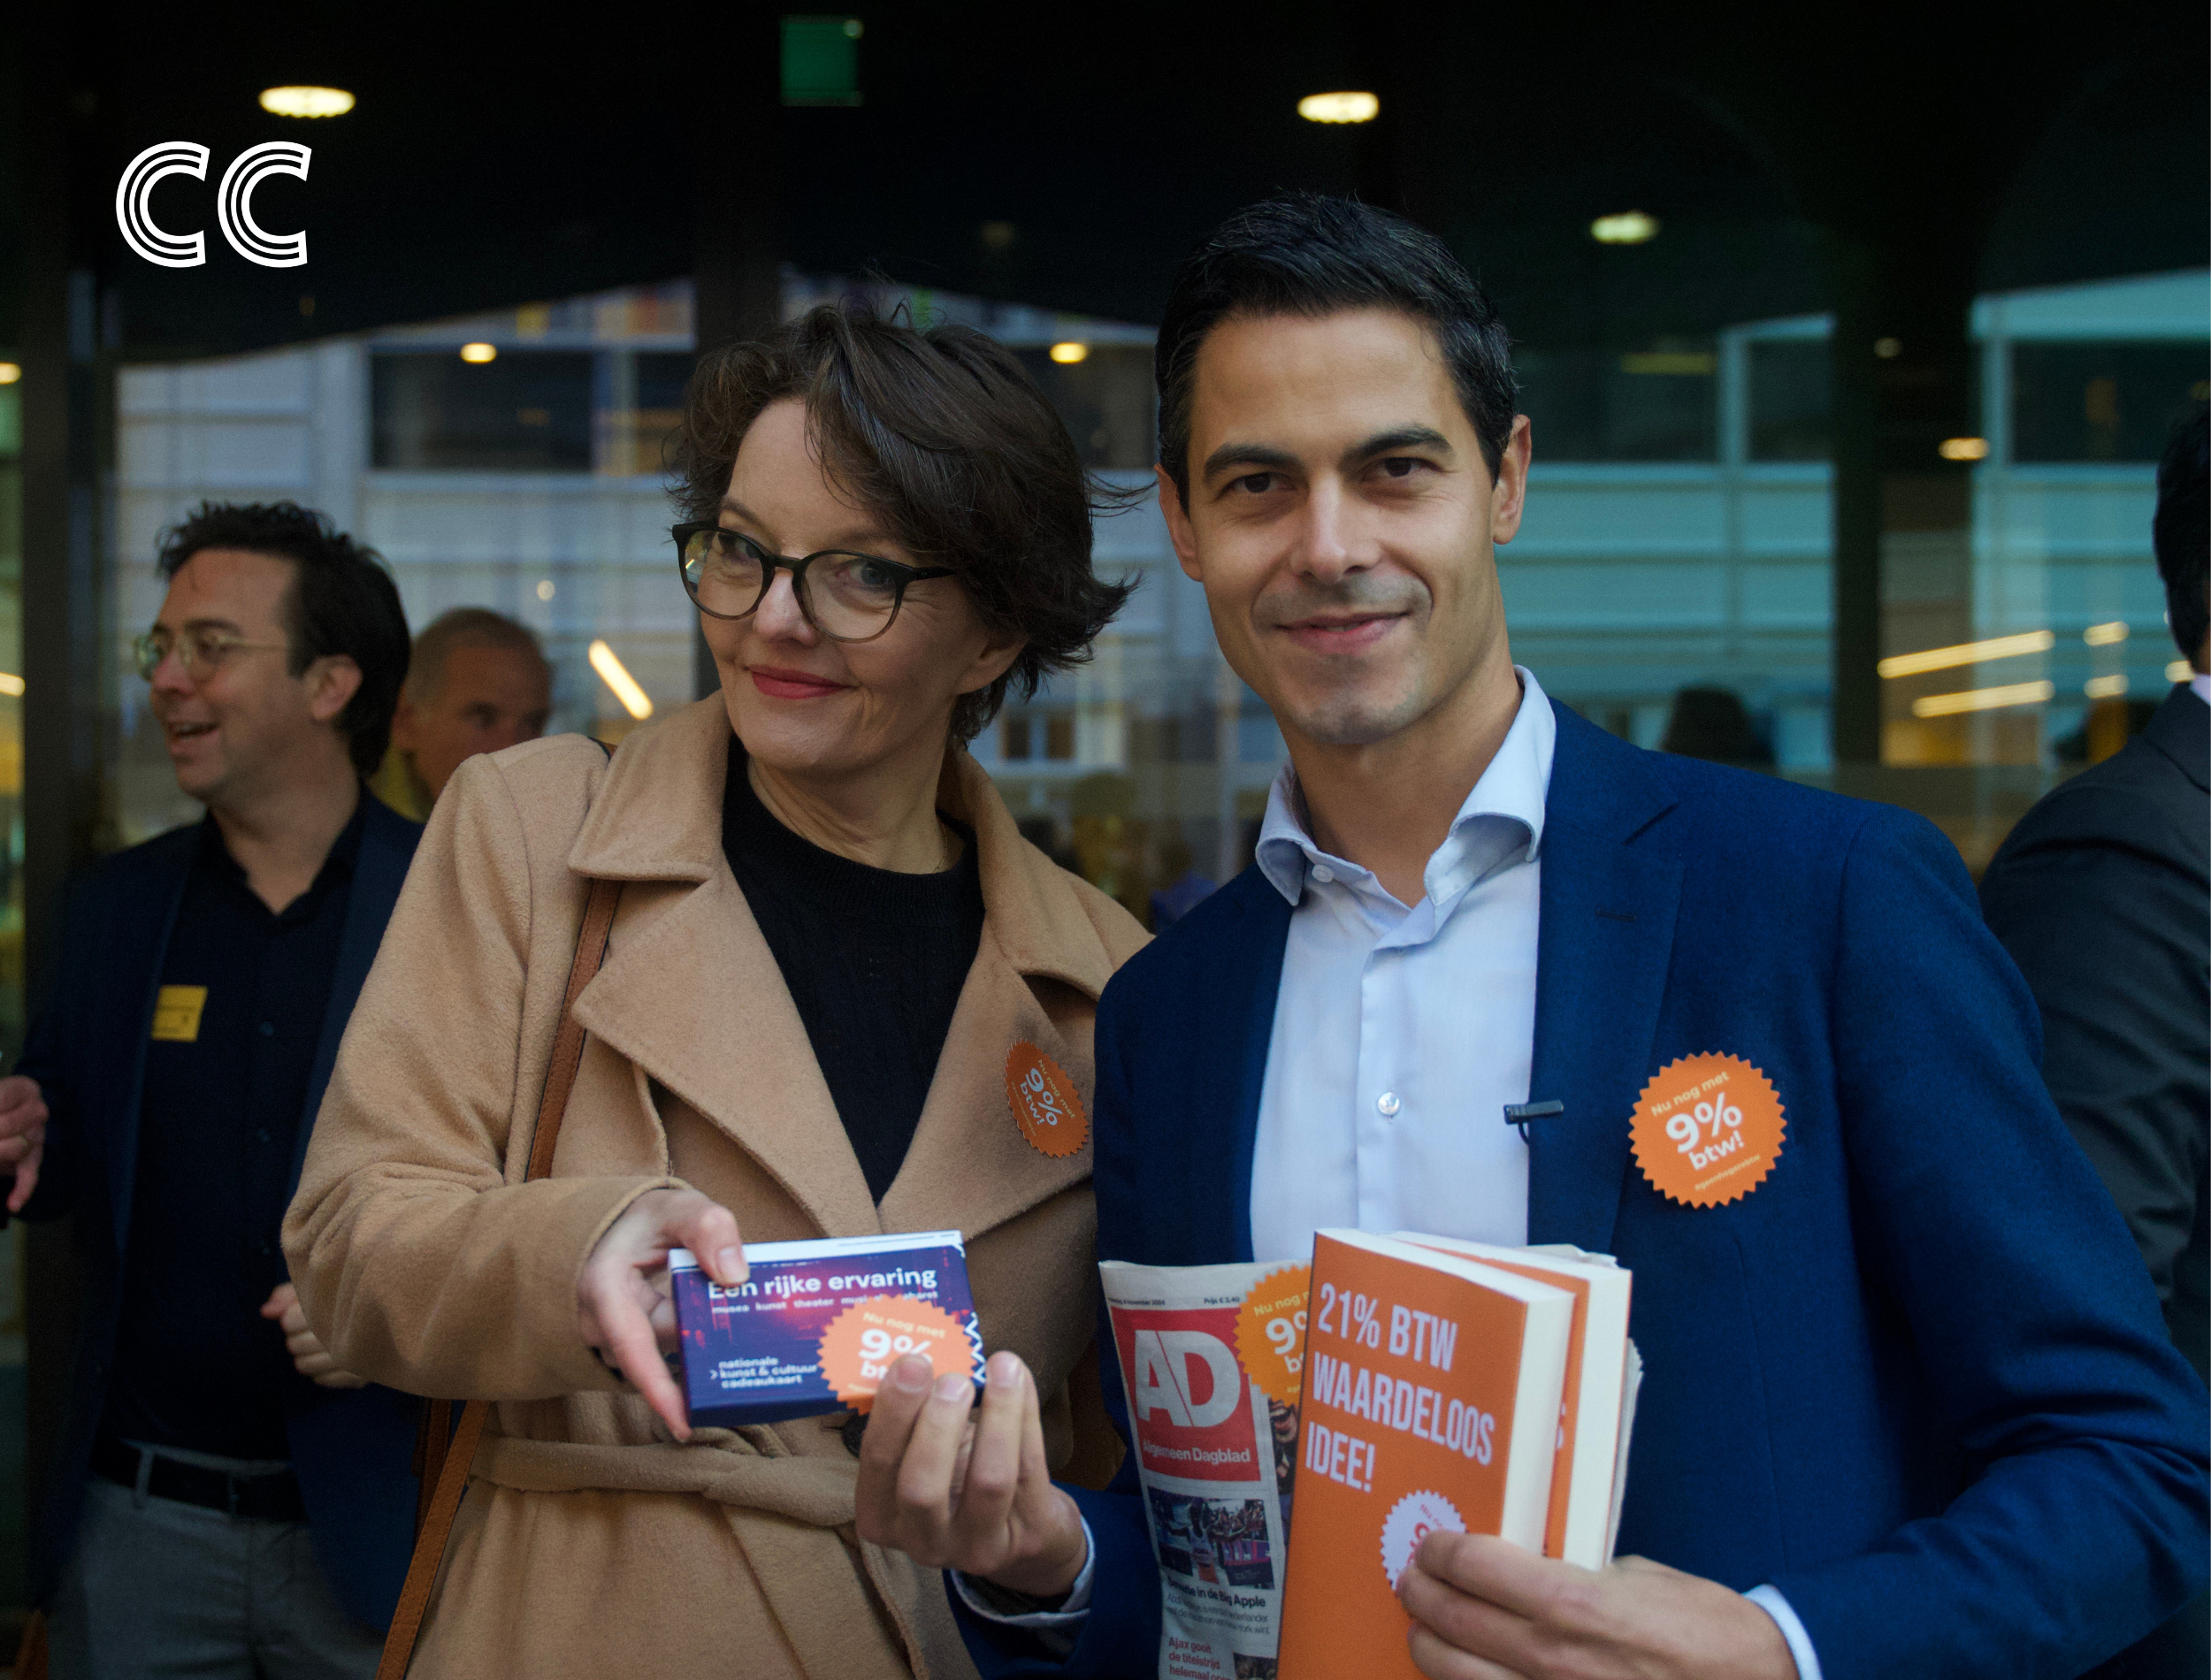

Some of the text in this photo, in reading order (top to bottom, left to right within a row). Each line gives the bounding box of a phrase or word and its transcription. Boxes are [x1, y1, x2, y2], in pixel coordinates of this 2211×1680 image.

[1020, 1081, 1044, 1125] btw!
[1025, 1067, 1063, 1126] 9%
[1038, 1059, 1075, 1119] Nu nog met
[1650, 1071, 1730, 1117] Nu nog met
[1665, 1091, 1742, 1154] 9%
[1688, 1129, 1745, 1171] btw!
[764, 1273, 822, 1300] rijke
[828, 1266, 938, 1290] ervaring
[754, 1301, 787, 1311] kunst
[792, 1297, 835, 1309] theater
[1253, 1303, 1274, 1317] Nu
[1274, 1294, 1302, 1310] nog
[863, 1310, 946, 1339] Nu nog met
[1318, 1281, 1458, 1373] 21% BTW
[718, 1355, 780, 1370] nationale
[719, 1367, 756, 1379] kunst
[771, 1363, 818, 1376] cultuur
[1135, 1330, 1241, 1428] AD
[721, 1374, 803, 1389] cadeaukaart
[1313, 1350, 1496, 1466] WAARDELOOS
[1191, 1447, 1251, 1465] Dagblad
[1304, 1420, 1376, 1493] IDEE!
[1196, 1586, 1206, 1598] in
[1233, 1593, 1266, 1609] Apple
[1168, 1637, 1190, 1651] Ajax
[1168, 1651, 1220, 1670] de titelstrijd
